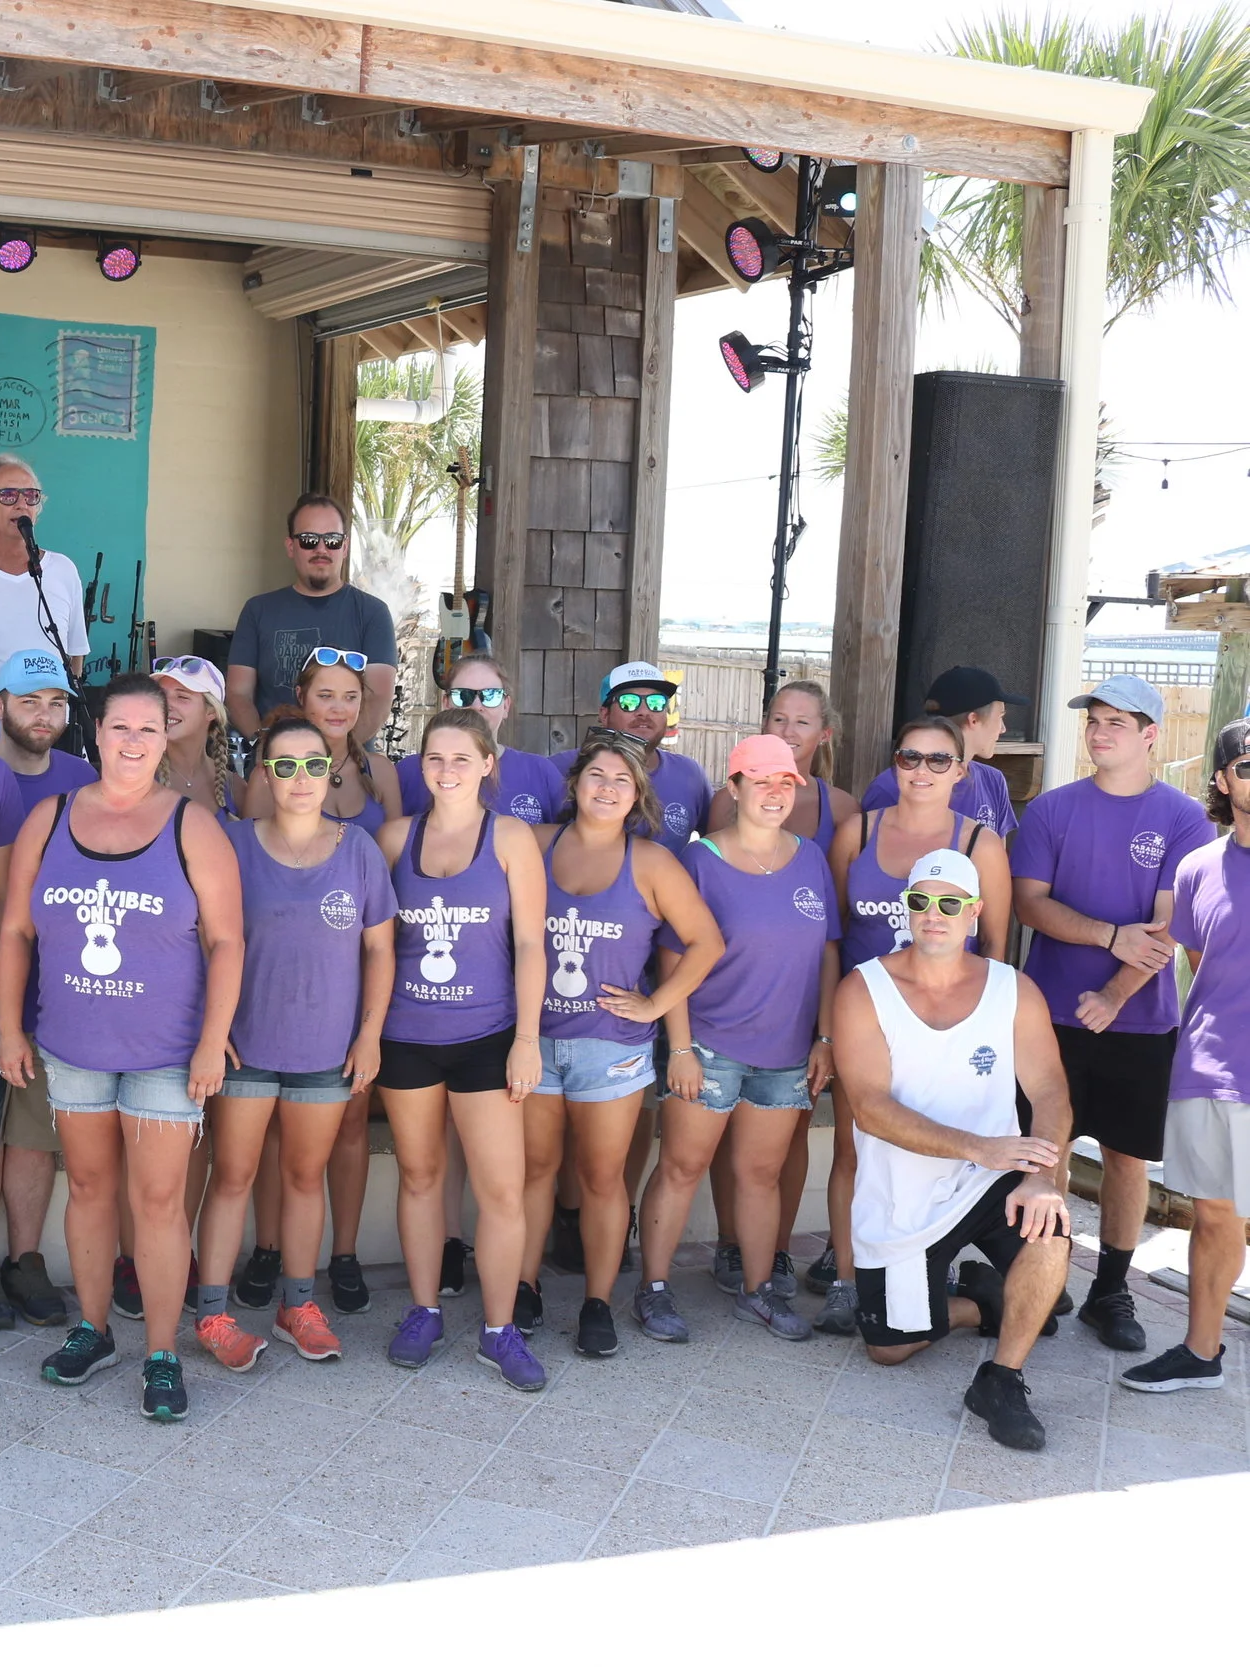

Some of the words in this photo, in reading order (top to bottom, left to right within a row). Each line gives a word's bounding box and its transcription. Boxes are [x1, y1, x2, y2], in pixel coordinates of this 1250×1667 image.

[0, 398, 21, 409] MAR
[43, 887, 98, 905] GOOD
[105, 890, 164, 915] VIBES
[856, 900, 904, 916] GOOD
[76, 904, 127, 926] ONLY
[399, 907, 437, 924] GOOD
[441, 906, 491, 924] VIBES
[887, 915, 910, 930] ON
[423, 924, 462, 941] ONLY
[545, 916, 570, 934] OD
[575, 919, 623, 940] VIBES
[552, 934, 594, 953] ONLY
[64, 973, 144, 993] PARADISE
[405, 981, 474, 996] PARADISE
[75, 986, 92, 994] BAR
[105, 990, 133, 998] GRILL
[544, 997, 596, 1009] ARADIS
